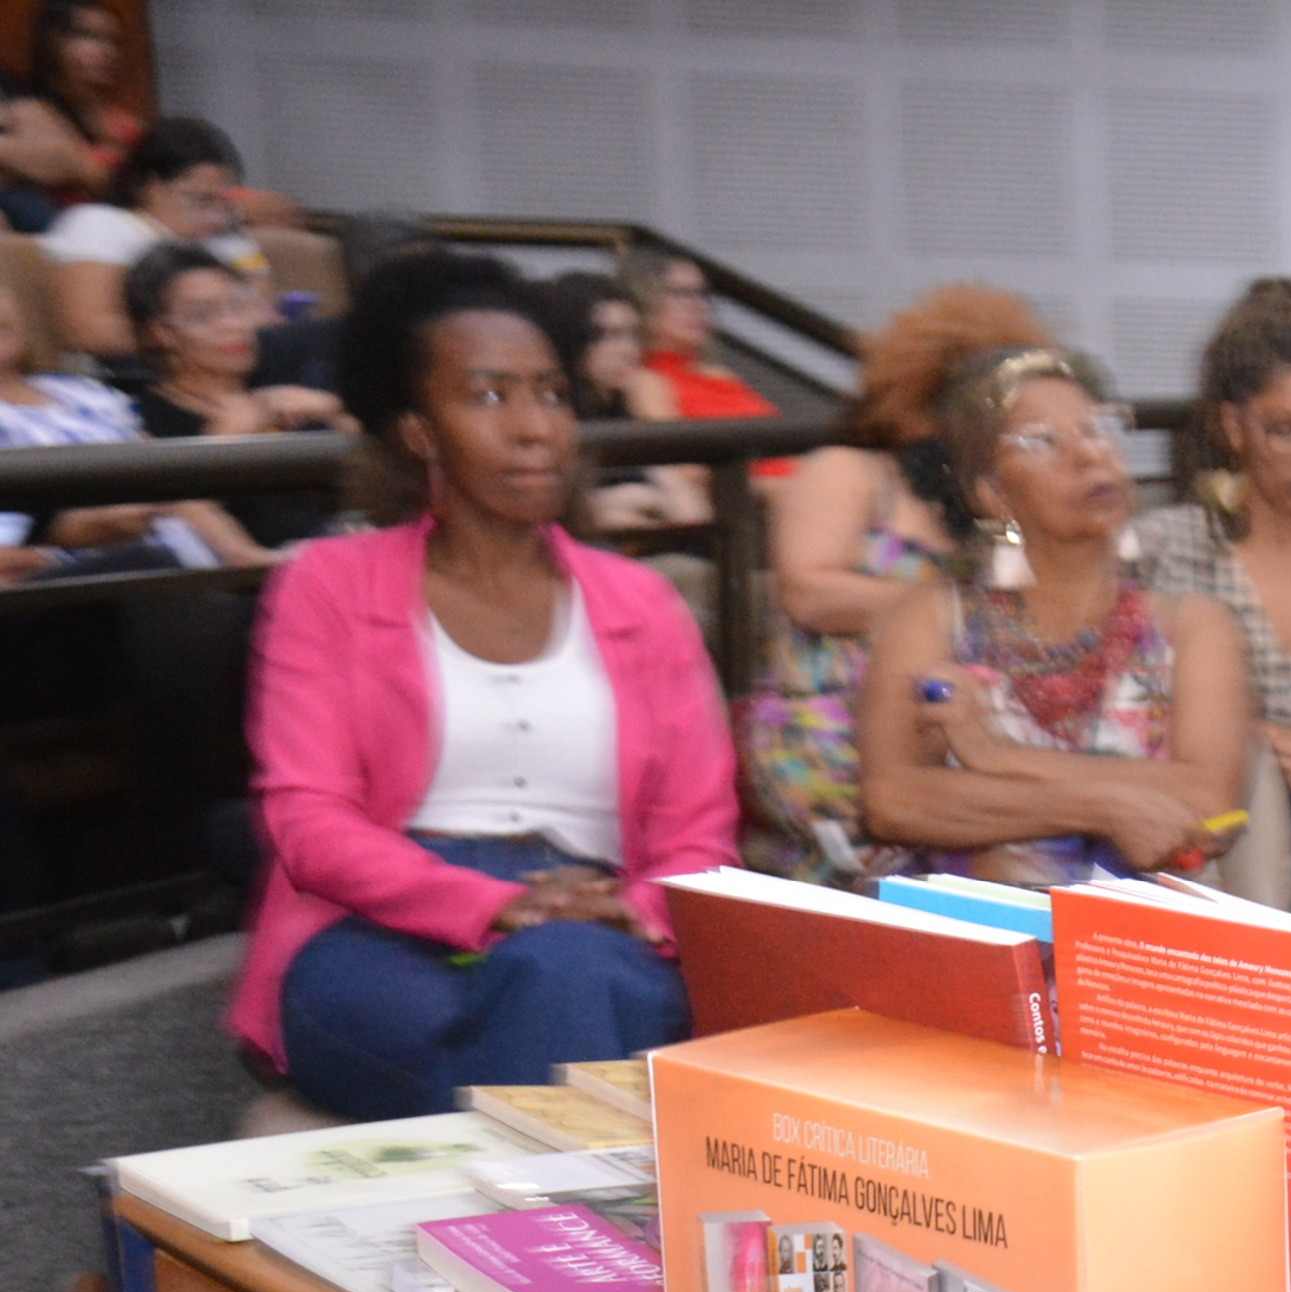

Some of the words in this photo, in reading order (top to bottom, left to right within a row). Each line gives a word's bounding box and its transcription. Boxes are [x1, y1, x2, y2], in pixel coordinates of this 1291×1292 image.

[1028, 992, 1047, 1045] Contos
[773, 1112, 801, 1143] BOX
[804, 1118, 856, 1157] CRÍTICA
[859, 1134, 929, 1178] LITERÁRIA
[706, 1136, 758, 1181] MARIA
[762, 1151, 783, 1188] DE
[787, 1156, 850, 1207] FÁTIMA
[854, 1176, 957, 1236] GONÇALVES
[962, 1204, 1009, 1250] LIMA
